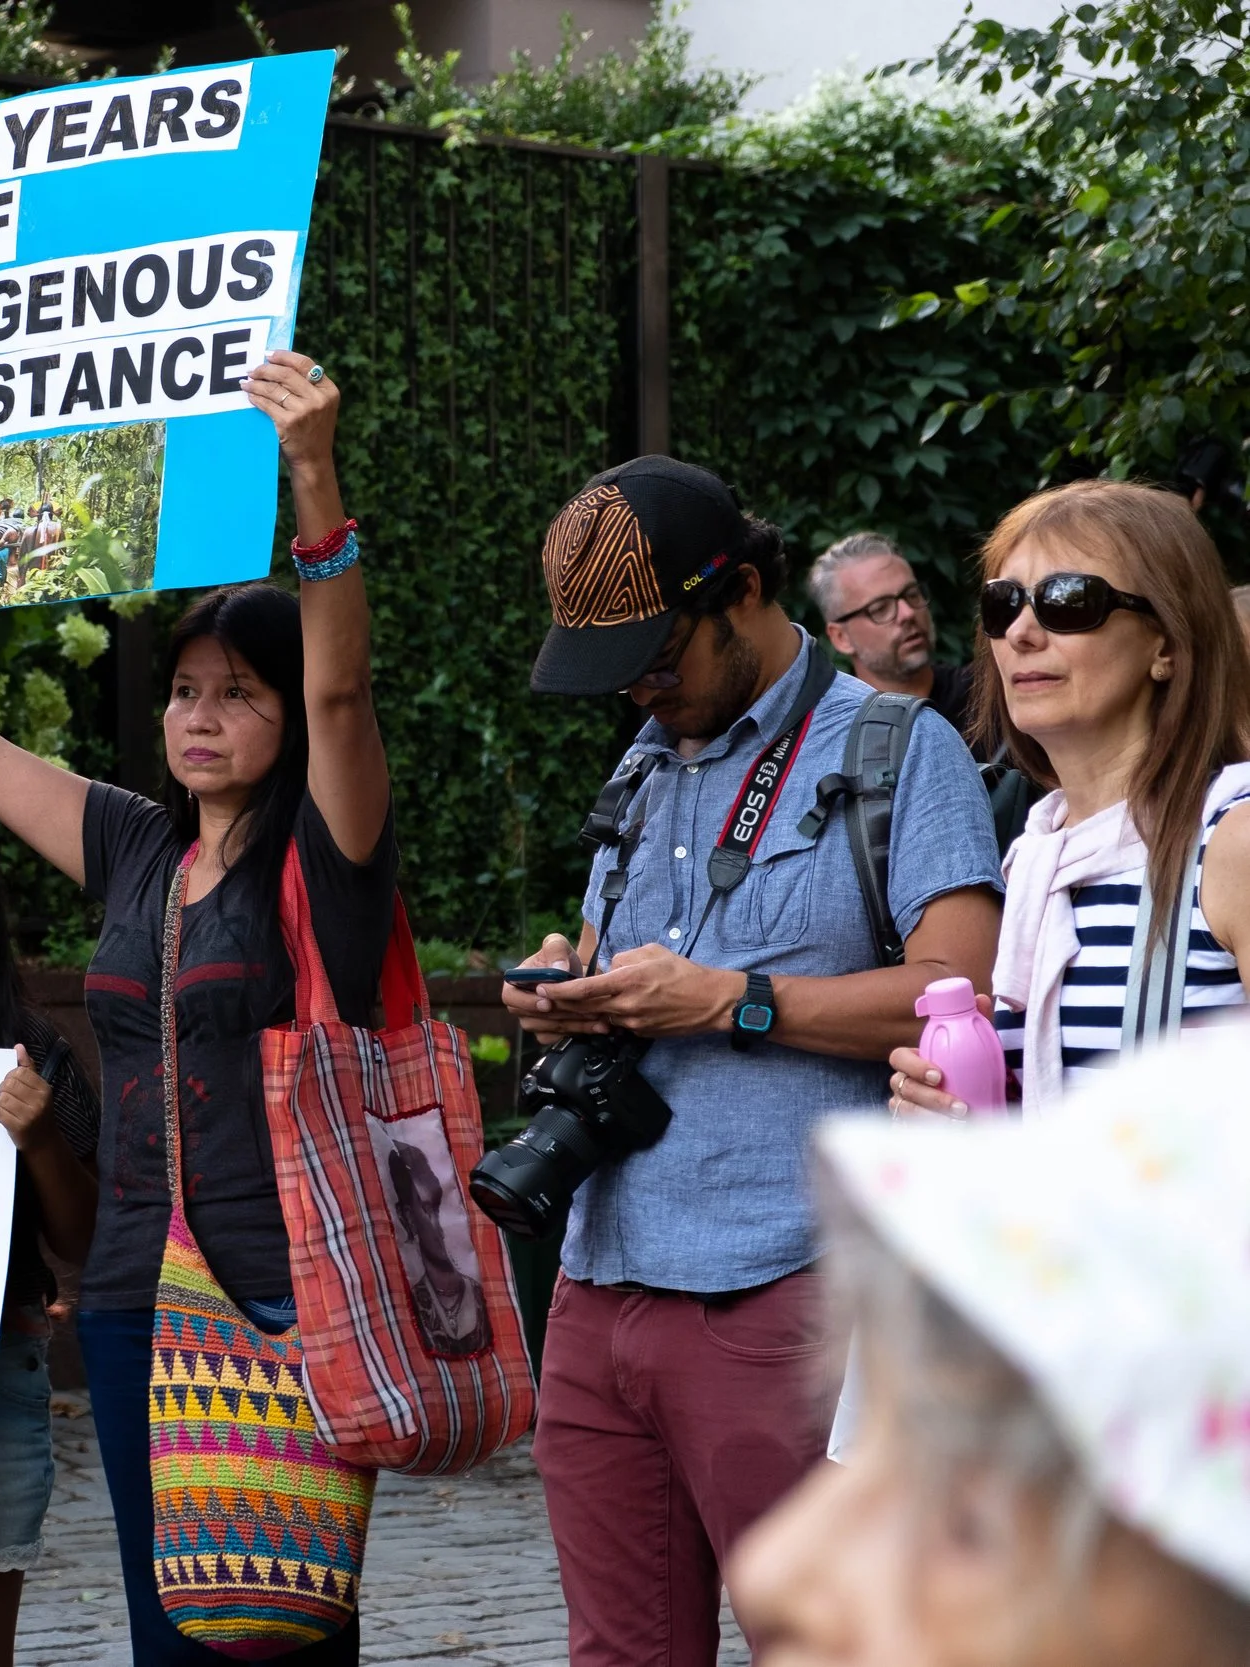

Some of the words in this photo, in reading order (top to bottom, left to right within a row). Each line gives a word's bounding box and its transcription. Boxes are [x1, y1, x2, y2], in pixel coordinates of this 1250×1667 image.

[4, 79, 243, 171] YEARS
[683, 552, 728, 591] COLOMBIA
[733, 790, 767, 842] EOS
[754, 761, 779, 789] 5D
[589, 1086, 602, 1095] EOS
